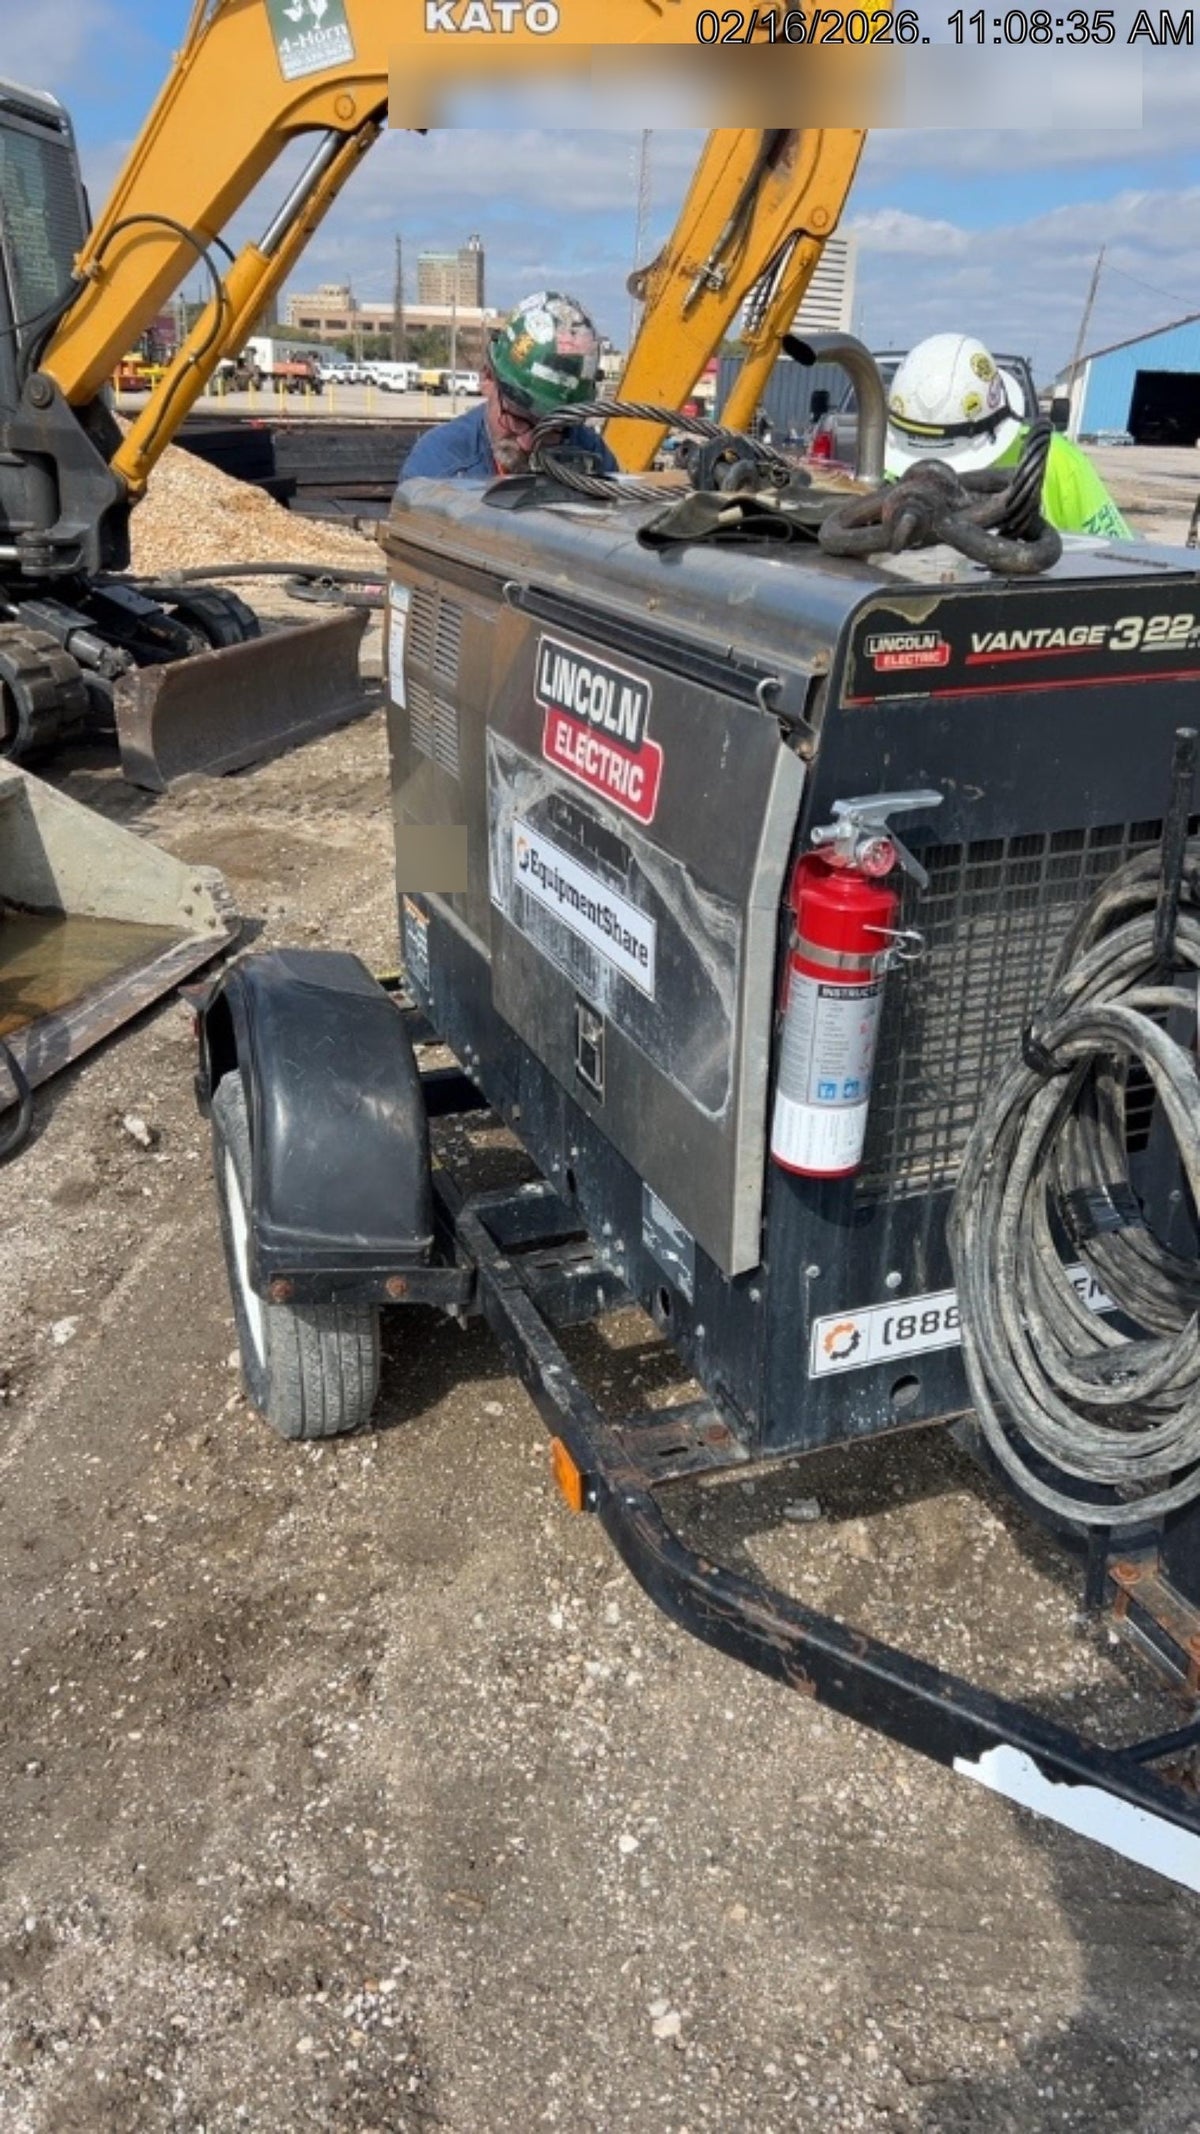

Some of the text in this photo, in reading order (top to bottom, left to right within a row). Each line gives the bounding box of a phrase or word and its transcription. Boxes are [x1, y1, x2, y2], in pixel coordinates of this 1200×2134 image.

[424, 0, 560, 35] KATO
[869, 634, 936, 653] LINCOLN
[970, 625, 1107, 653] VANTAGE
[883, 651, 941, 666] ELECTRIC
[540, 649, 643, 743] LINCOLN
[554, 720, 645, 803] ELECTRIC
[530, 848, 649, 969] EquipmentShare
